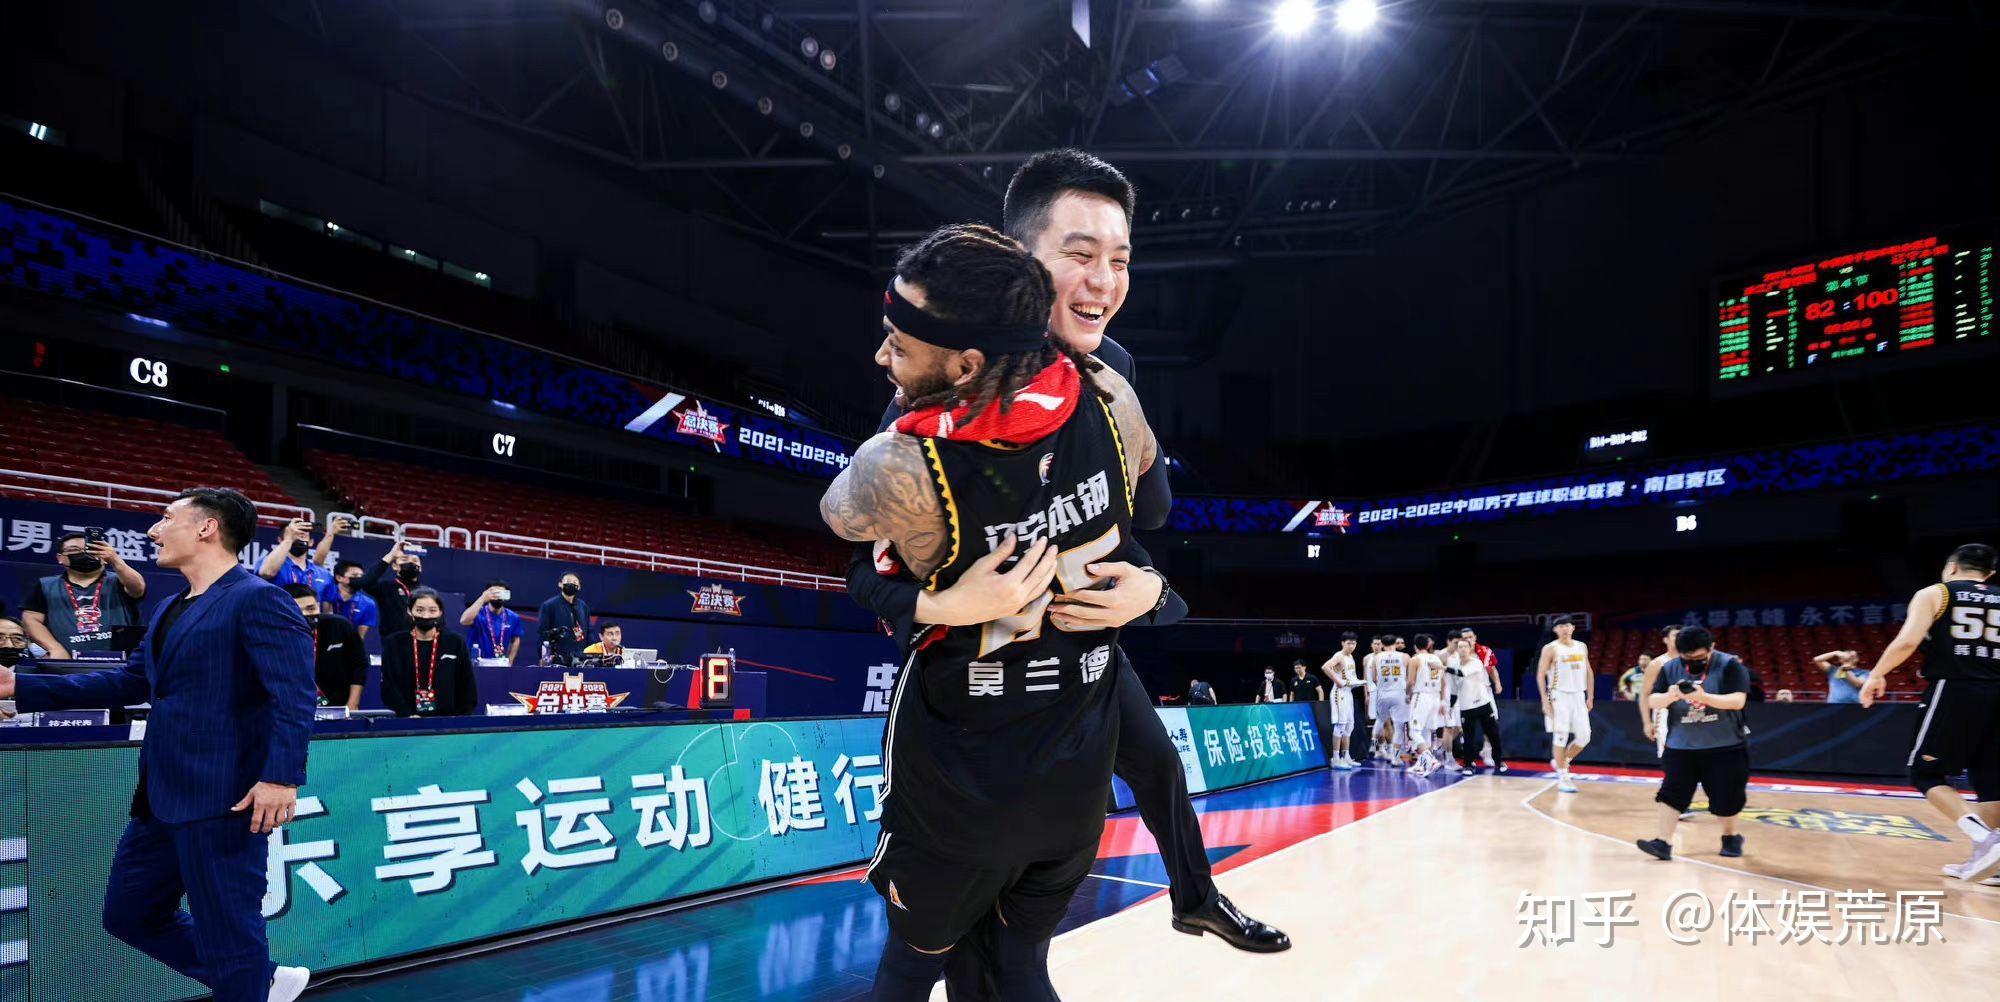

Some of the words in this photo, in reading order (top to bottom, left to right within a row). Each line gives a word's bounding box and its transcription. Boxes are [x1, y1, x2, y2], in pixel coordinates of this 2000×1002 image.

[1805, 300, 1836, 320] 82
[1854, 288, 1899, 311] 100
[129, 357, 169, 388] C8
[491, 433, 517, 458] C7
[738, 426, 856, 470] 2021-2022中
[1676, 514, 1698, 532] B6
[968, 644, 1110, 698] 莫兰德
[537, 692, 608, 714] 总决赛
[541, 683, 564, 692] 2021
[862, 663, 900, 712] 忠
[757, 752, 885, 836] 健行
